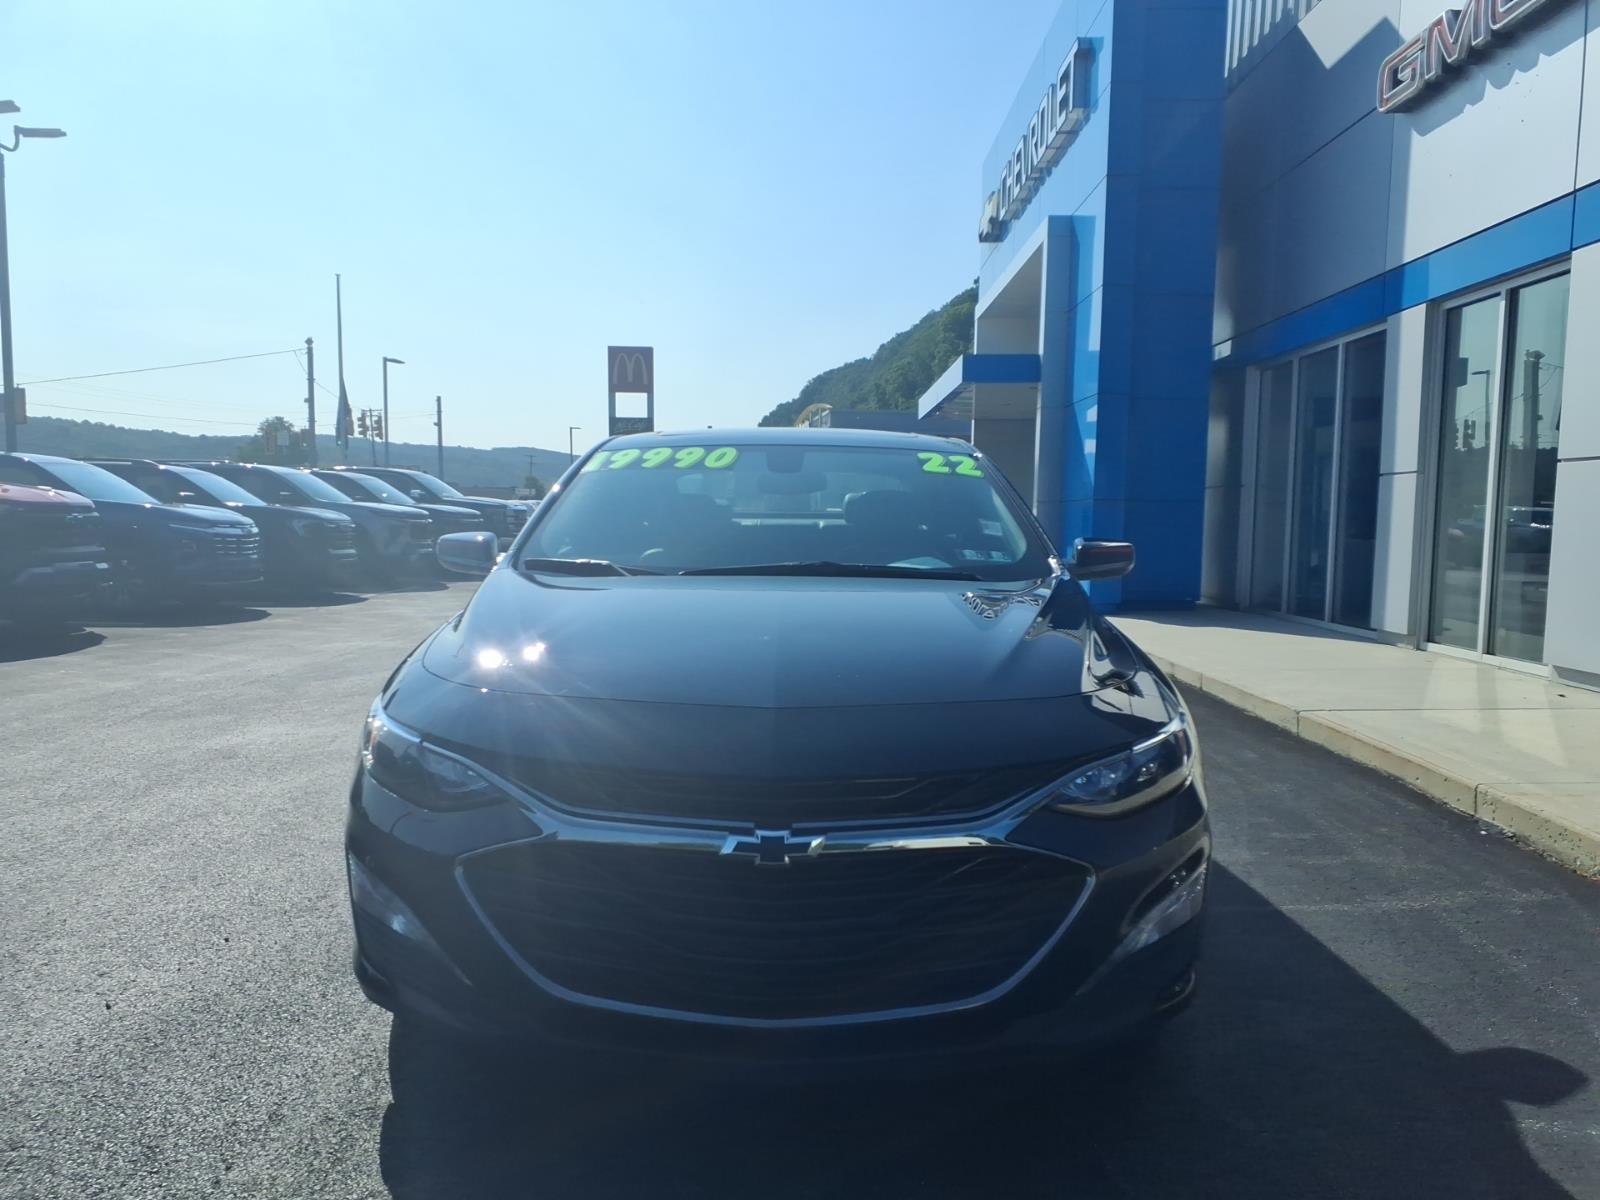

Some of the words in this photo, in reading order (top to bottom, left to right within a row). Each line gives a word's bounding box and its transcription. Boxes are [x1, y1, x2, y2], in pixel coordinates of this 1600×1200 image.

[998, 40, 1082, 222] CHEVROLET
[580, 447, 738, 473] 19990
[917, 452, 984, 478] 22
